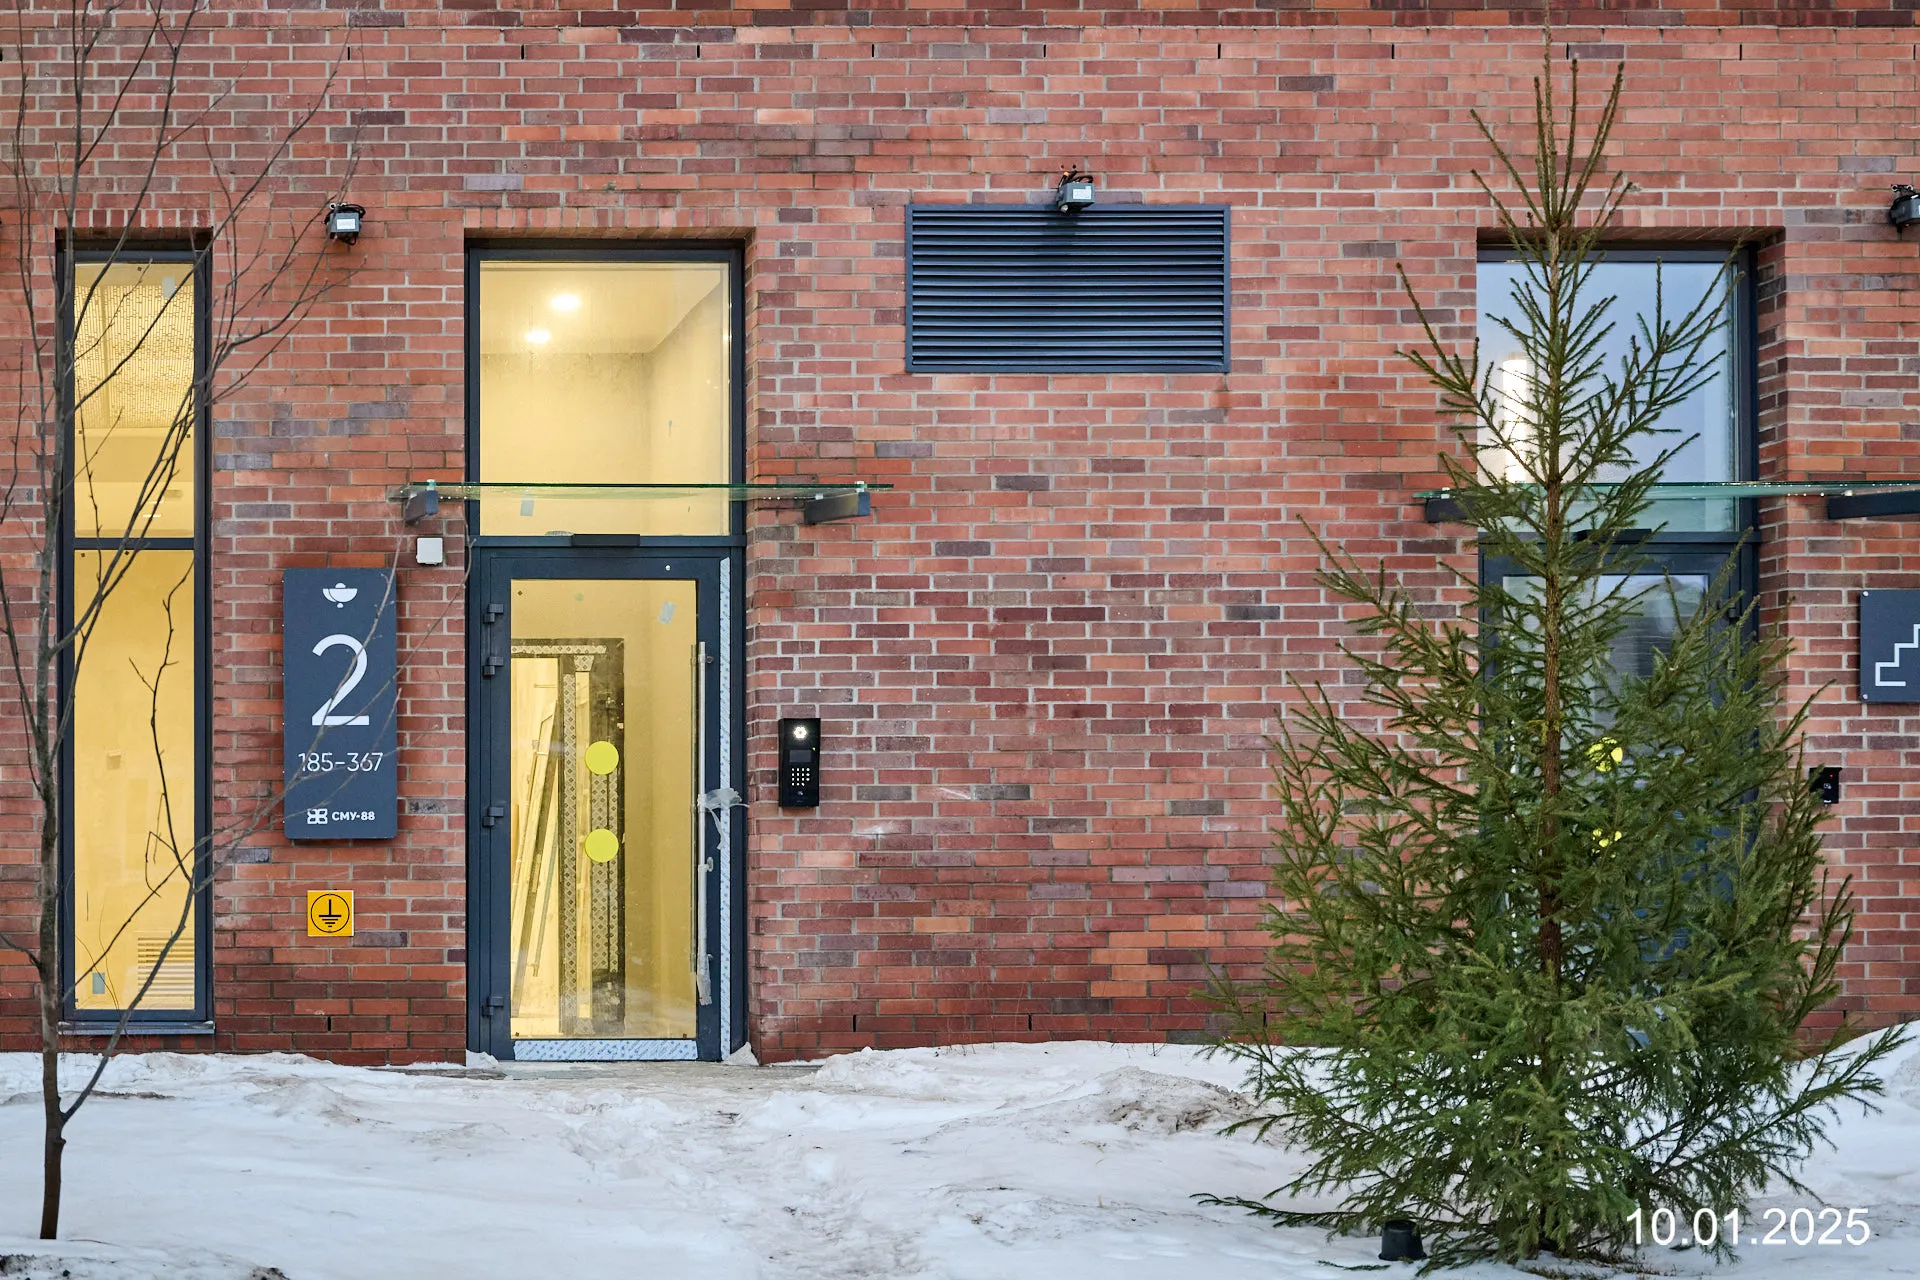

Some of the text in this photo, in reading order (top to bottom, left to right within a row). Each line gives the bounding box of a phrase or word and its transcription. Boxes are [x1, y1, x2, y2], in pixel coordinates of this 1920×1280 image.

[311, 633, 370, 726] 2
[298, 752, 384, 772] 185-367
[331, 810, 376, 821] СМУ-88
